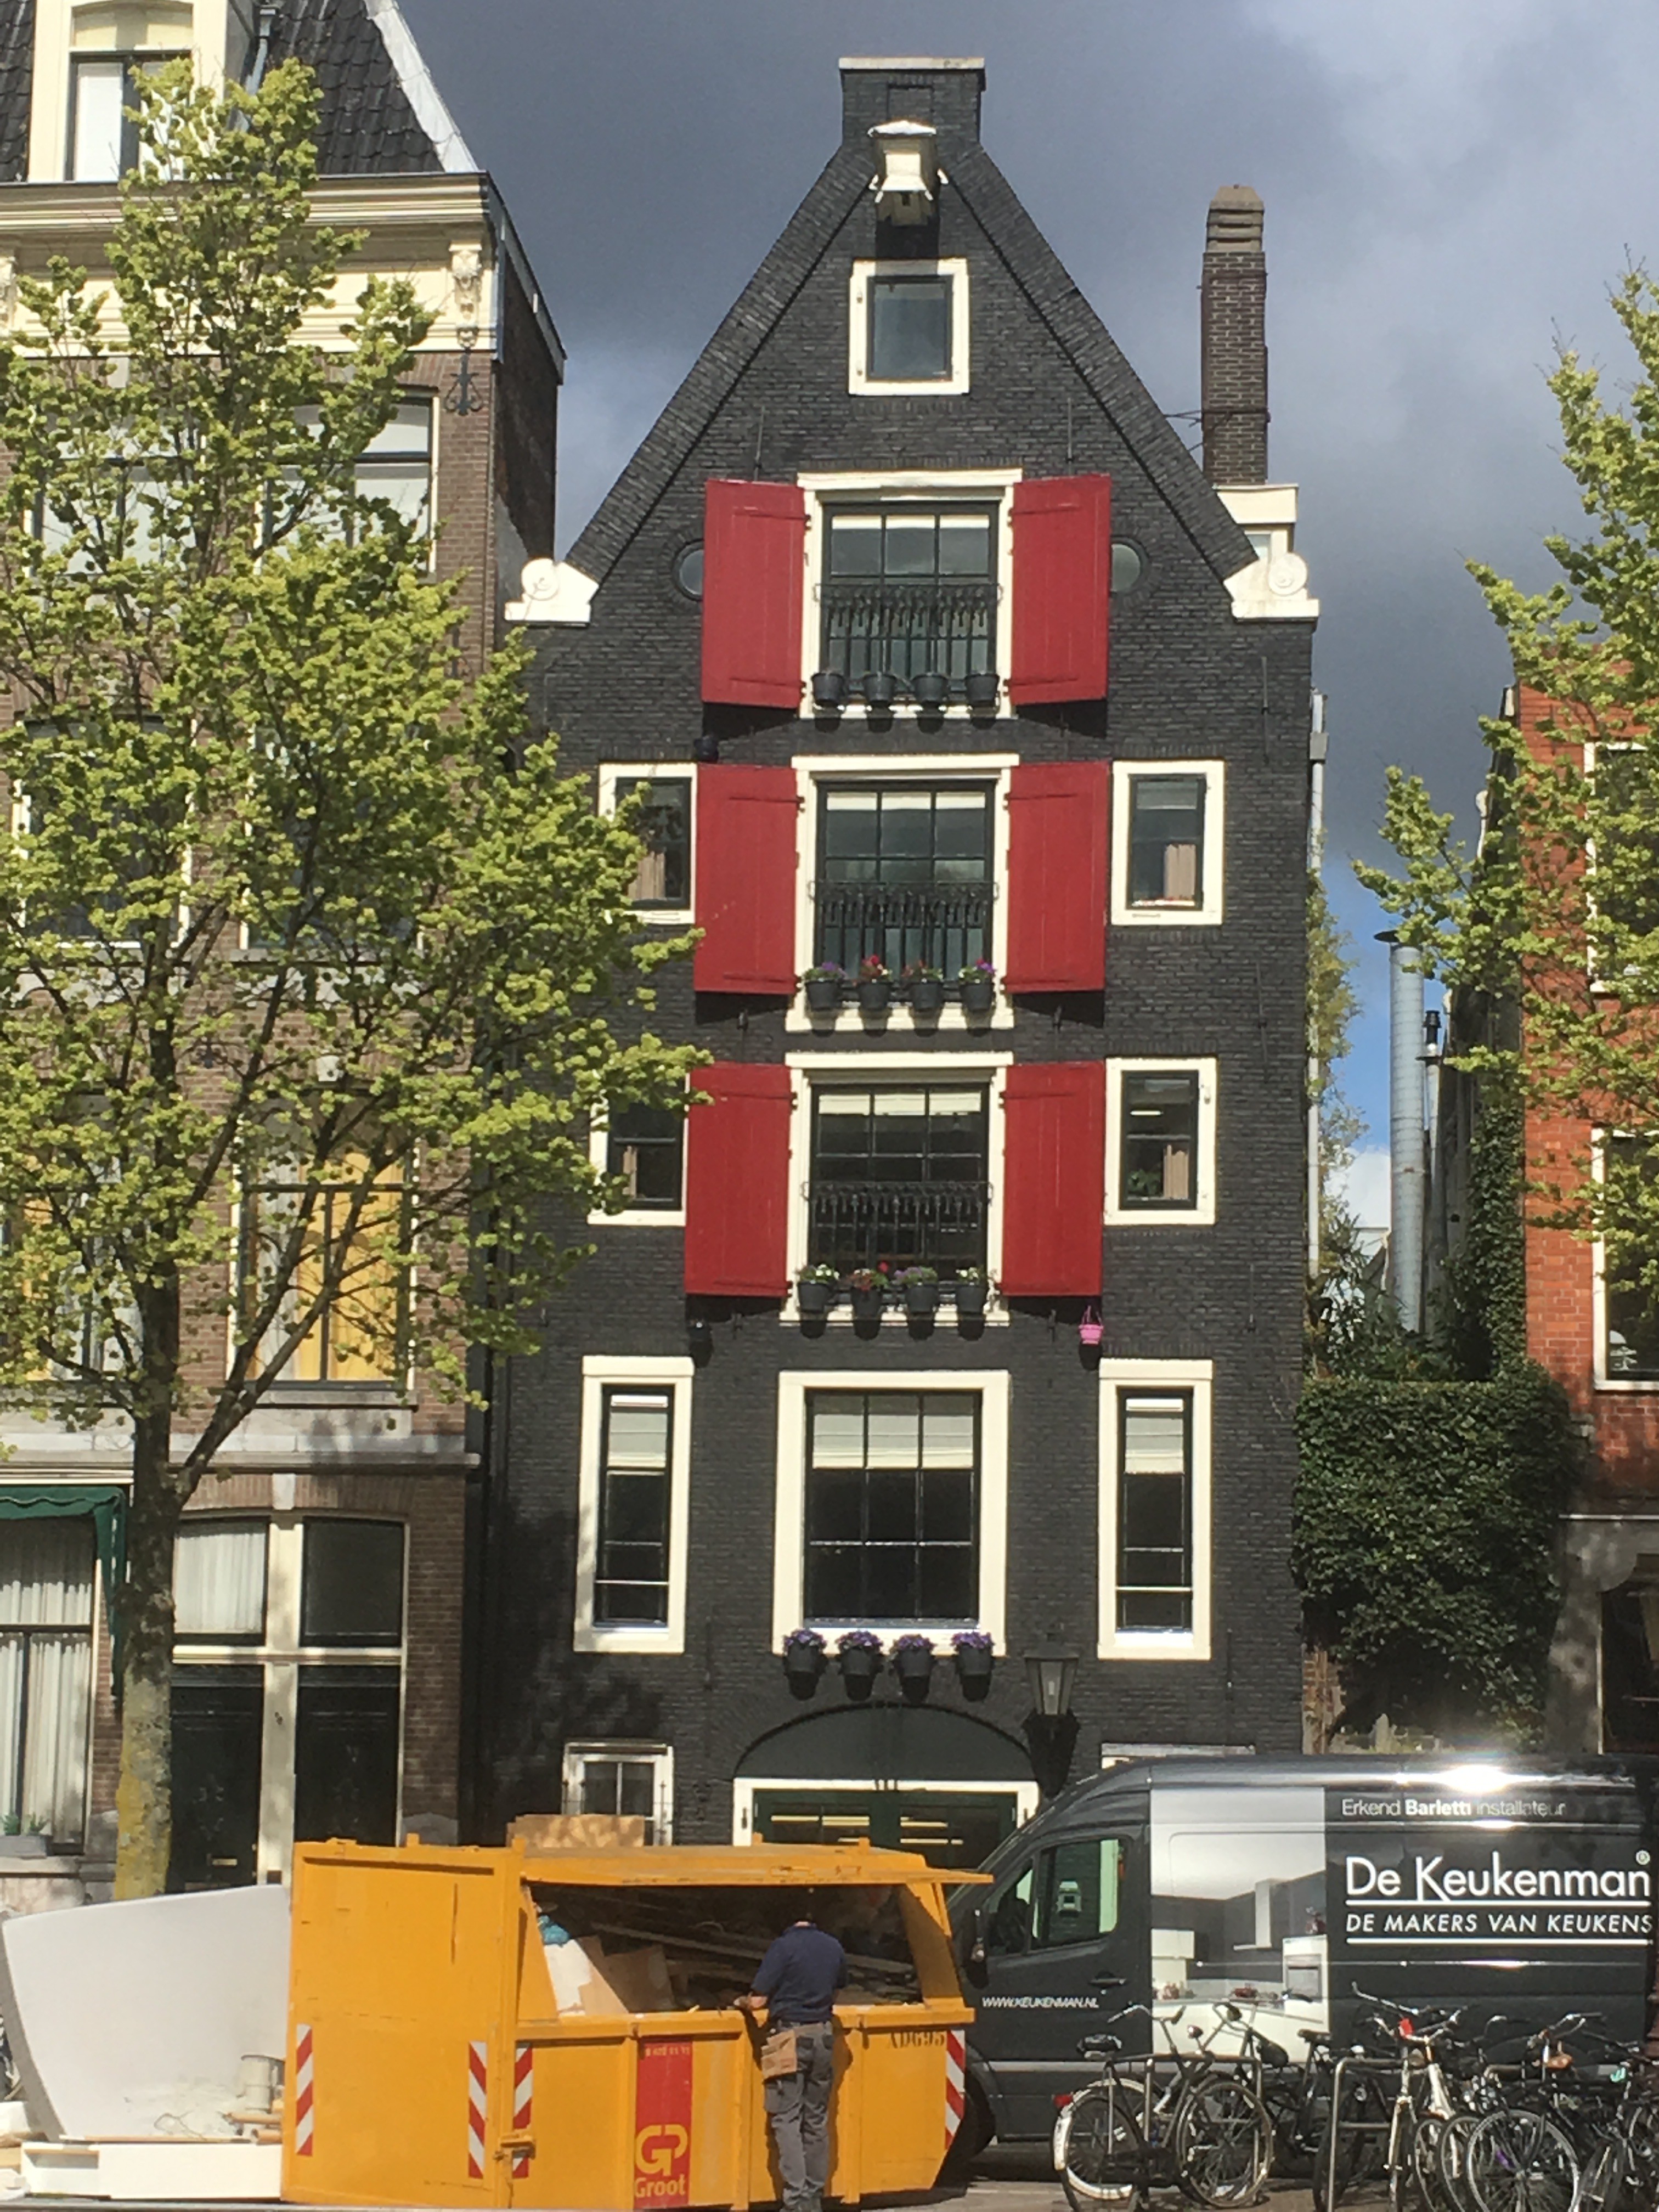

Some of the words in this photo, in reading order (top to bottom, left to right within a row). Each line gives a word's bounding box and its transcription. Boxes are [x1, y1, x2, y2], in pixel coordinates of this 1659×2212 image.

[1342, 1799, 1401, 1815] Erkend
[1405, 1799, 1471, 1816] Barletti
[1346, 1857, 1401, 1896] De
[1415, 1851, 1650, 1901] Keukenman
[1346, 1914, 1374, 1932] DE
[1384, 1914, 1477, 1932] MAKERS
[1488, 1915, 1536, 1933] VAN
[1547, 1915, 1653, 1933] KEUKENS
[635, 2173, 686, 2198] Groot
